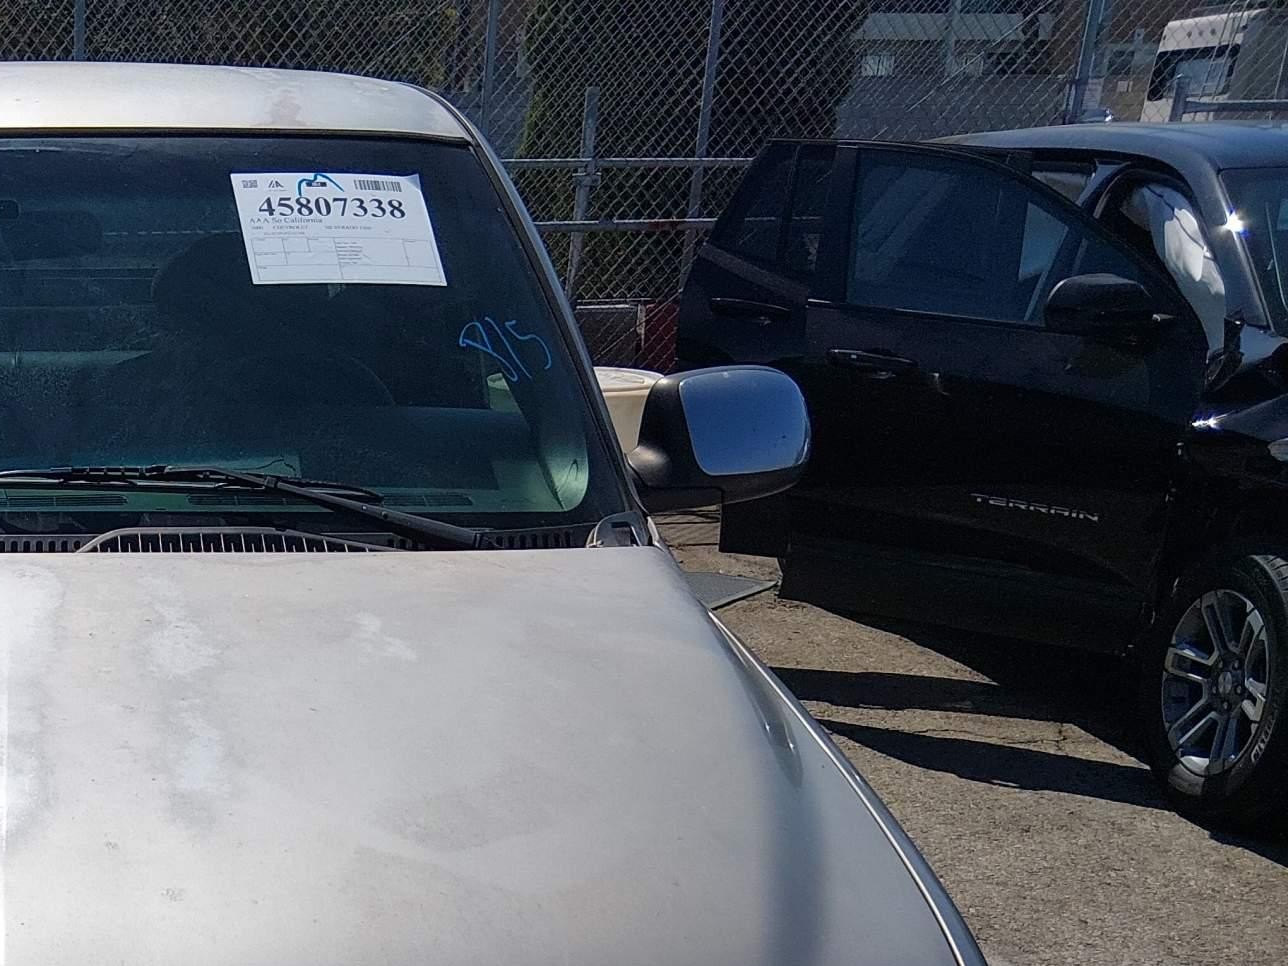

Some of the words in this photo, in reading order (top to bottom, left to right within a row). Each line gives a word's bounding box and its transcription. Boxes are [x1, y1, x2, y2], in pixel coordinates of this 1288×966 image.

[258, 196, 407, 219] 45807338
[284, 216, 324, 224] California
[970, 492, 1100, 521] TERRAIN
